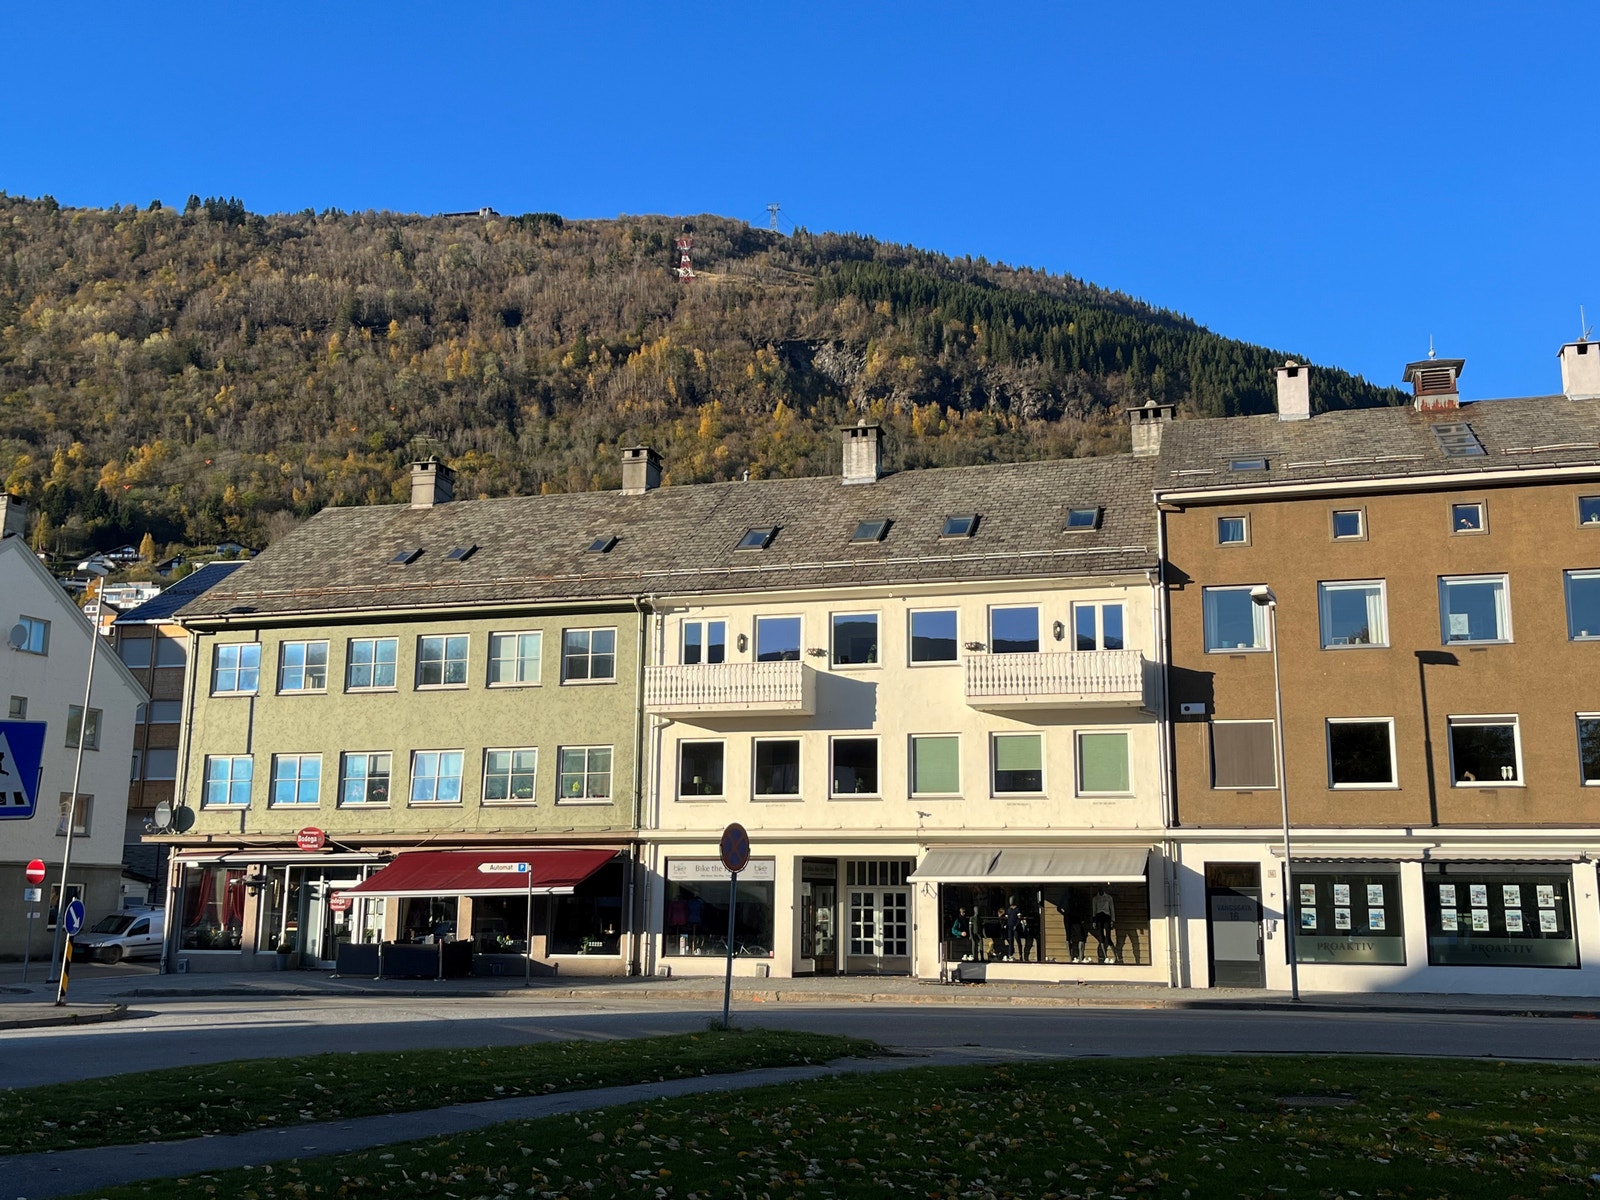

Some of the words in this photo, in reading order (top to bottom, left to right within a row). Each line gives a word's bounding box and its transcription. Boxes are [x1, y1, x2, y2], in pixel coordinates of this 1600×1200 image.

[298, 835, 317, 843] Bodega
[695, 864, 710, 872] Bike
[711, 864, 722, 872] the
[1317, 942, 1374, 956] PROAKTIV
[1471, 944, 1533, 958] PROAKTIV
